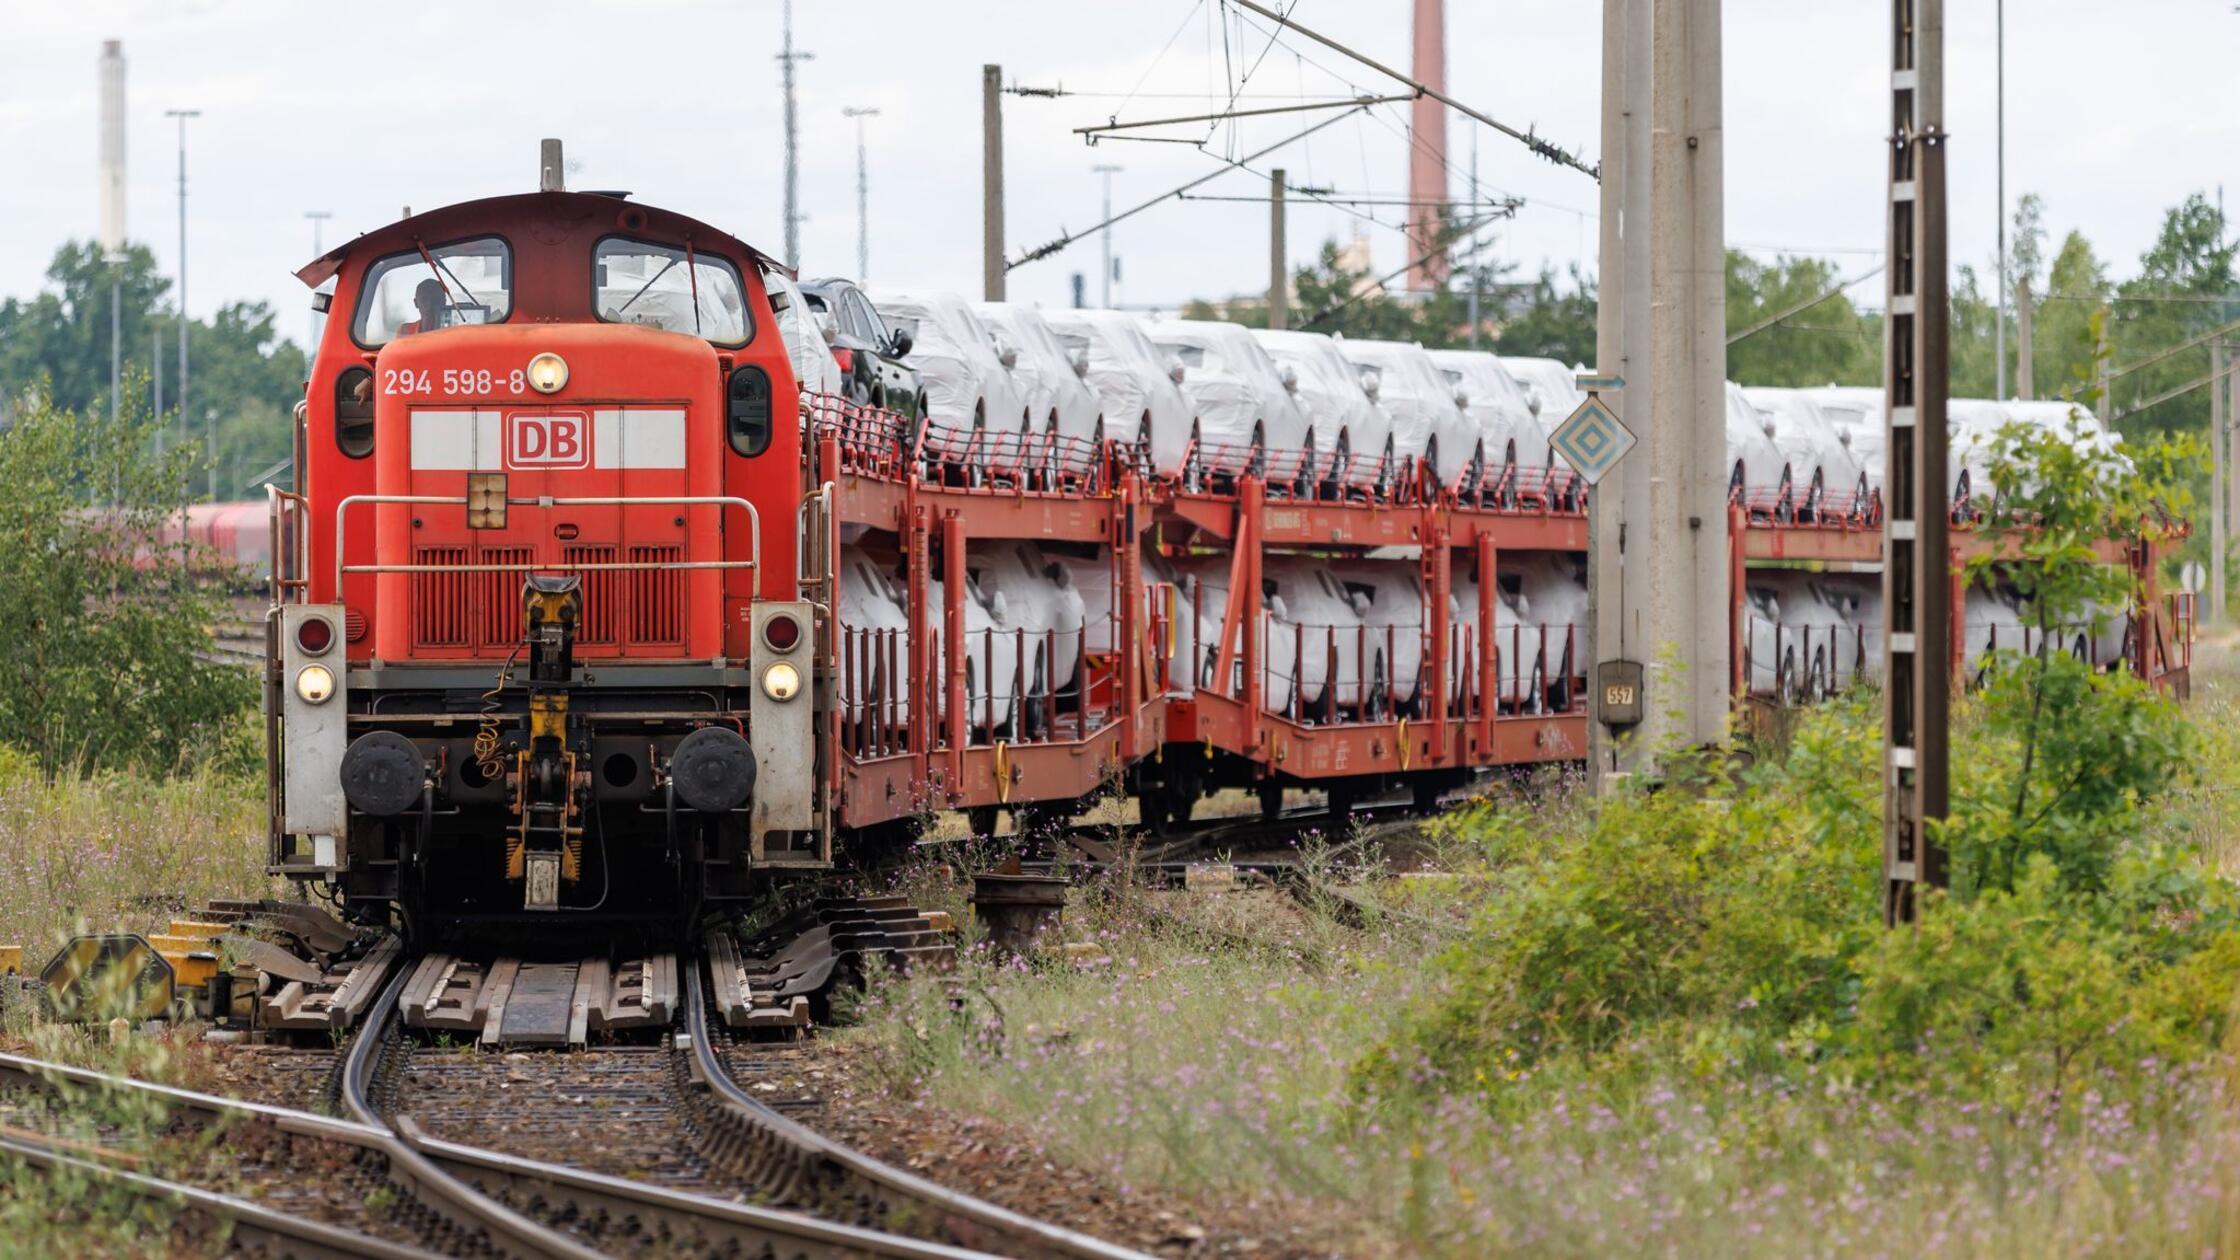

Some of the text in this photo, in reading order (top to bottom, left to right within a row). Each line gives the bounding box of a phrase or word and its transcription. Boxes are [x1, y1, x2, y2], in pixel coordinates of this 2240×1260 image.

[384, 369, 525, 395] 294 598-8
[517, 421, 579, 459] DB
